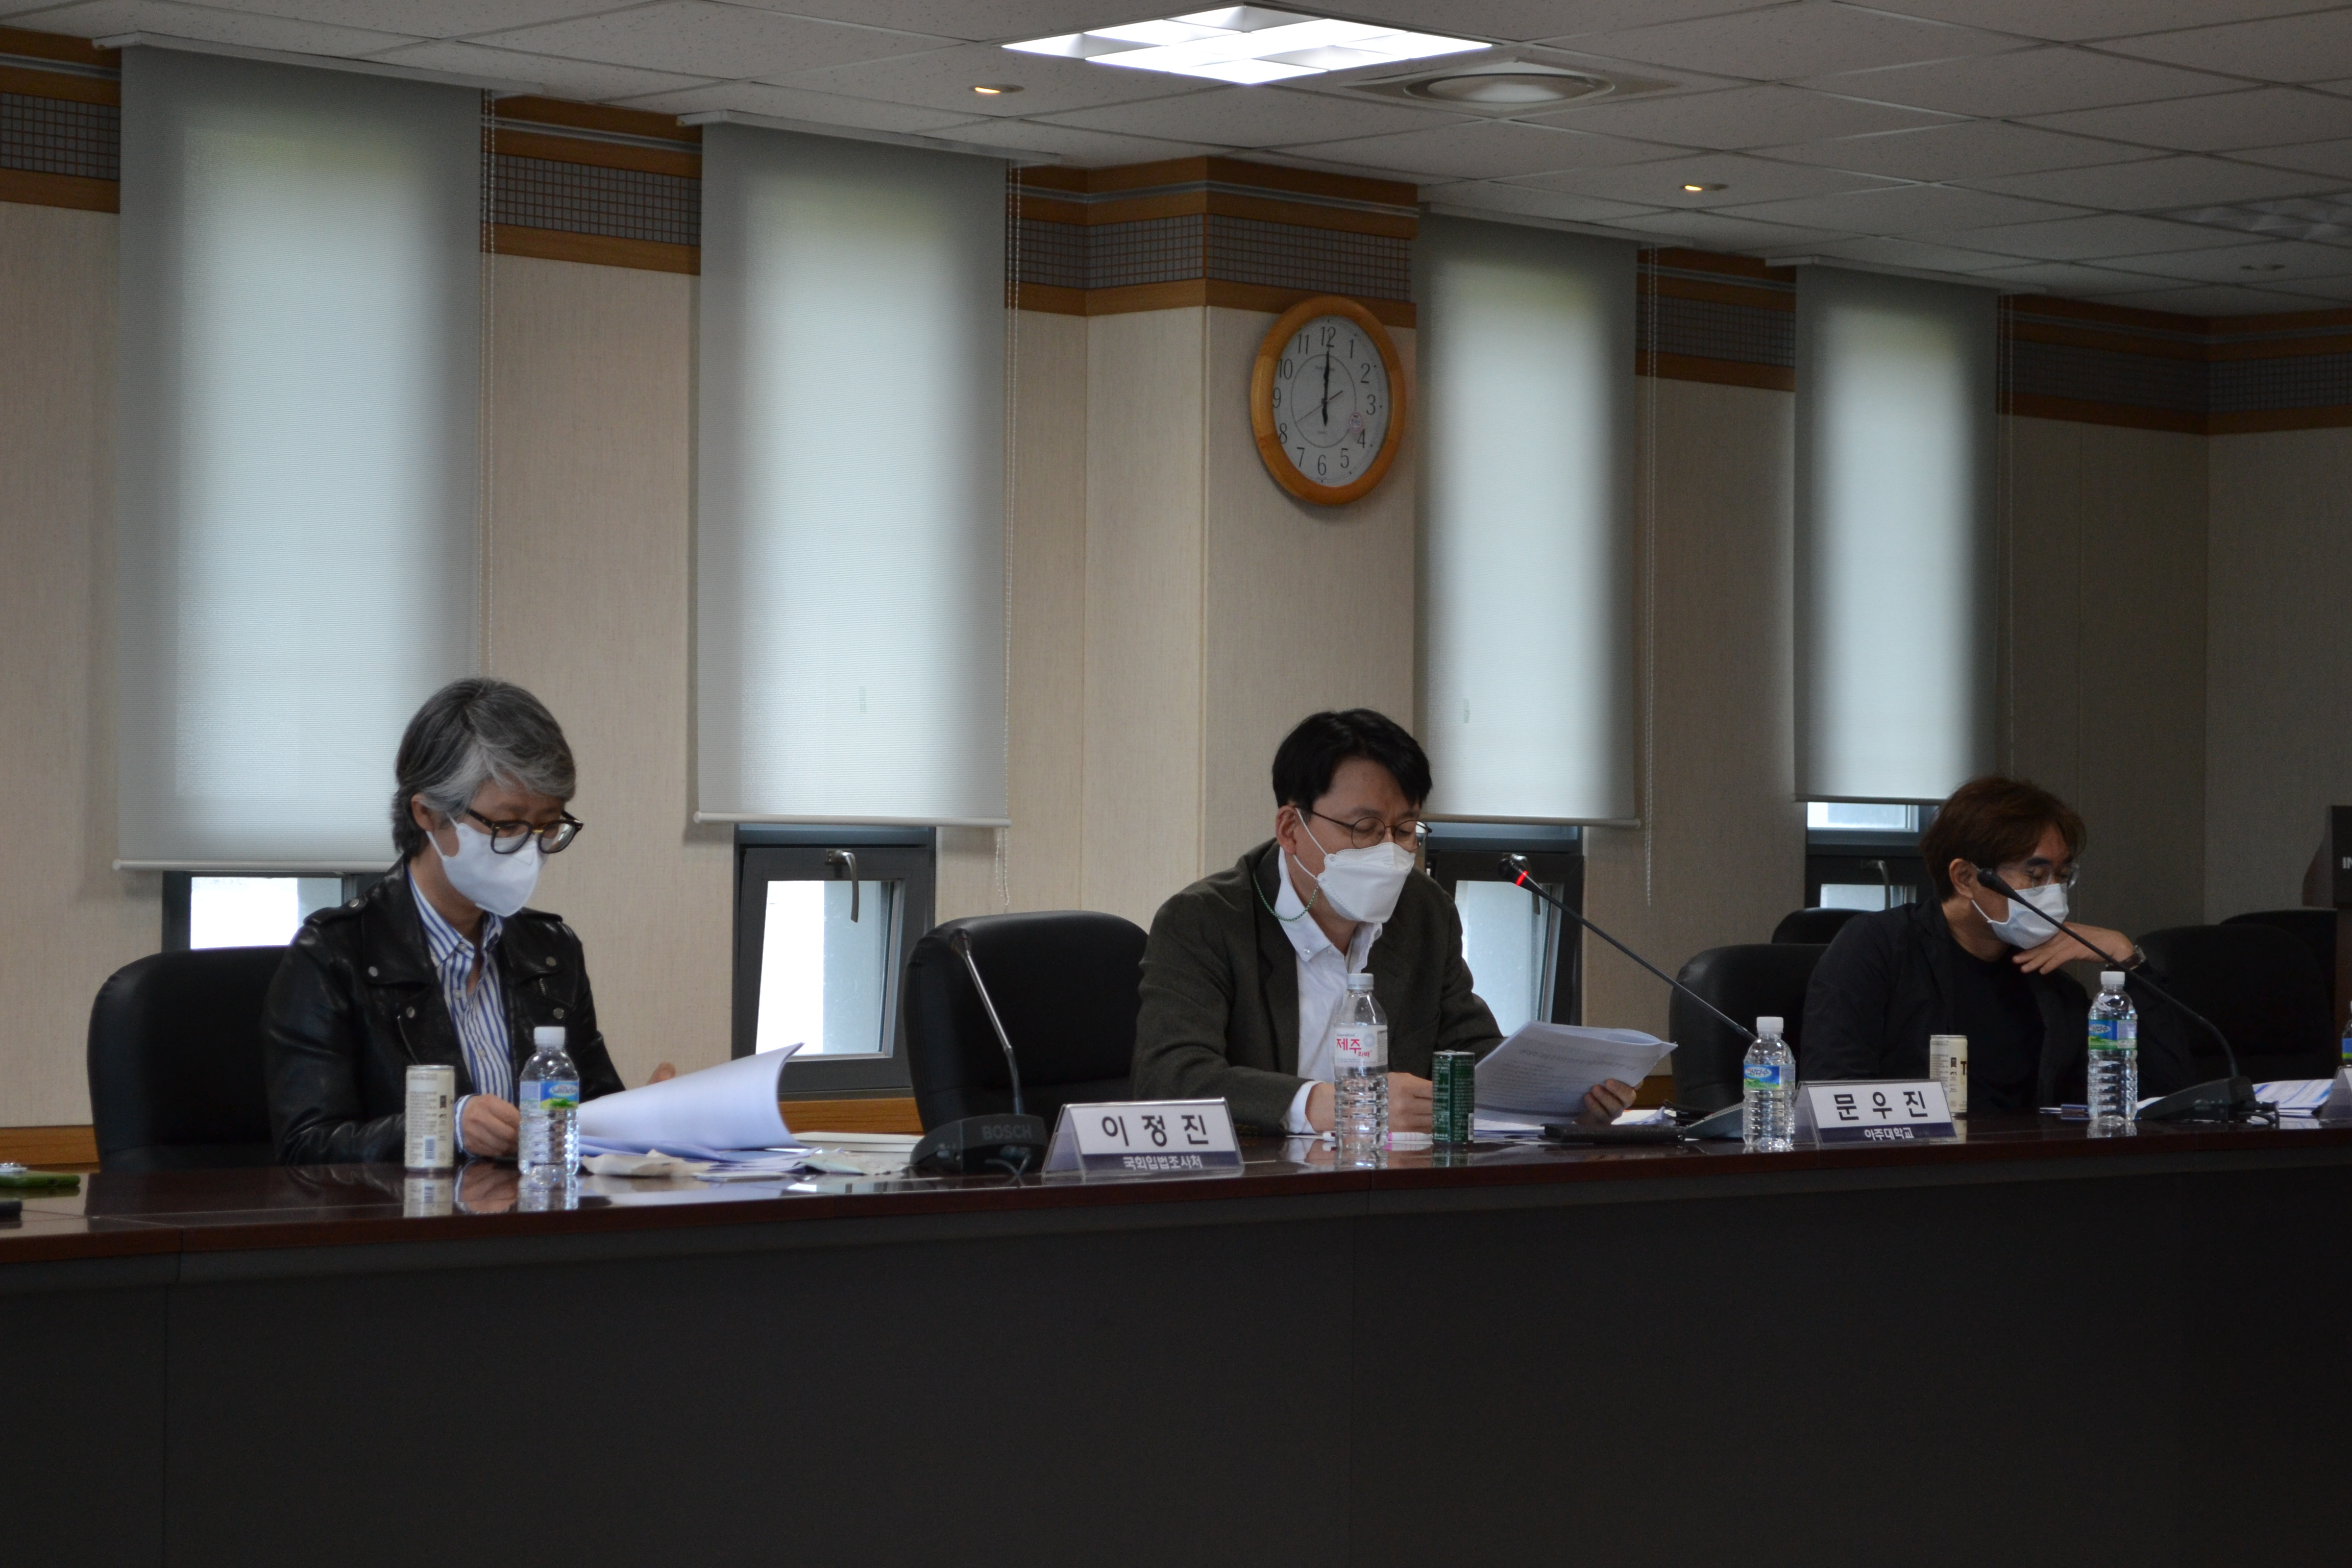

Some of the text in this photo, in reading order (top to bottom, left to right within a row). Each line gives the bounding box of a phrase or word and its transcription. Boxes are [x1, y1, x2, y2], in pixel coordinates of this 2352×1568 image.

[1298, 334, 1309, 354] 11
[1321, 326, 1336, 348] 12
[1349, 339, 1355, 359] 1
[1279, 358, 1293, 379] 10
[1360, 362, 1370, 383] 2
[1273, 387, 1282, 408] 9
[1366, 394, 1376, 415] 3
[1279, 423, 1288, 444] 8
[1357, 428, 1366, 449] 4
[1296, 446, 1305, 467] 7
[1317, 454, 1326, 476] 6
[1340, 448, 1349, 469] 5
[1336, 1038, 1362, 1054] 제주
[1833, 1090, 1928, 1121] 문우진
[982, 1123, 1032, 1141] BOSCH
[1101, 1114, 1209, 1147] 이정진
[1864, 1127, 1914, 1141] 아주대학교
[1123, 1155, 1202, 1170] 국회입법조사처
